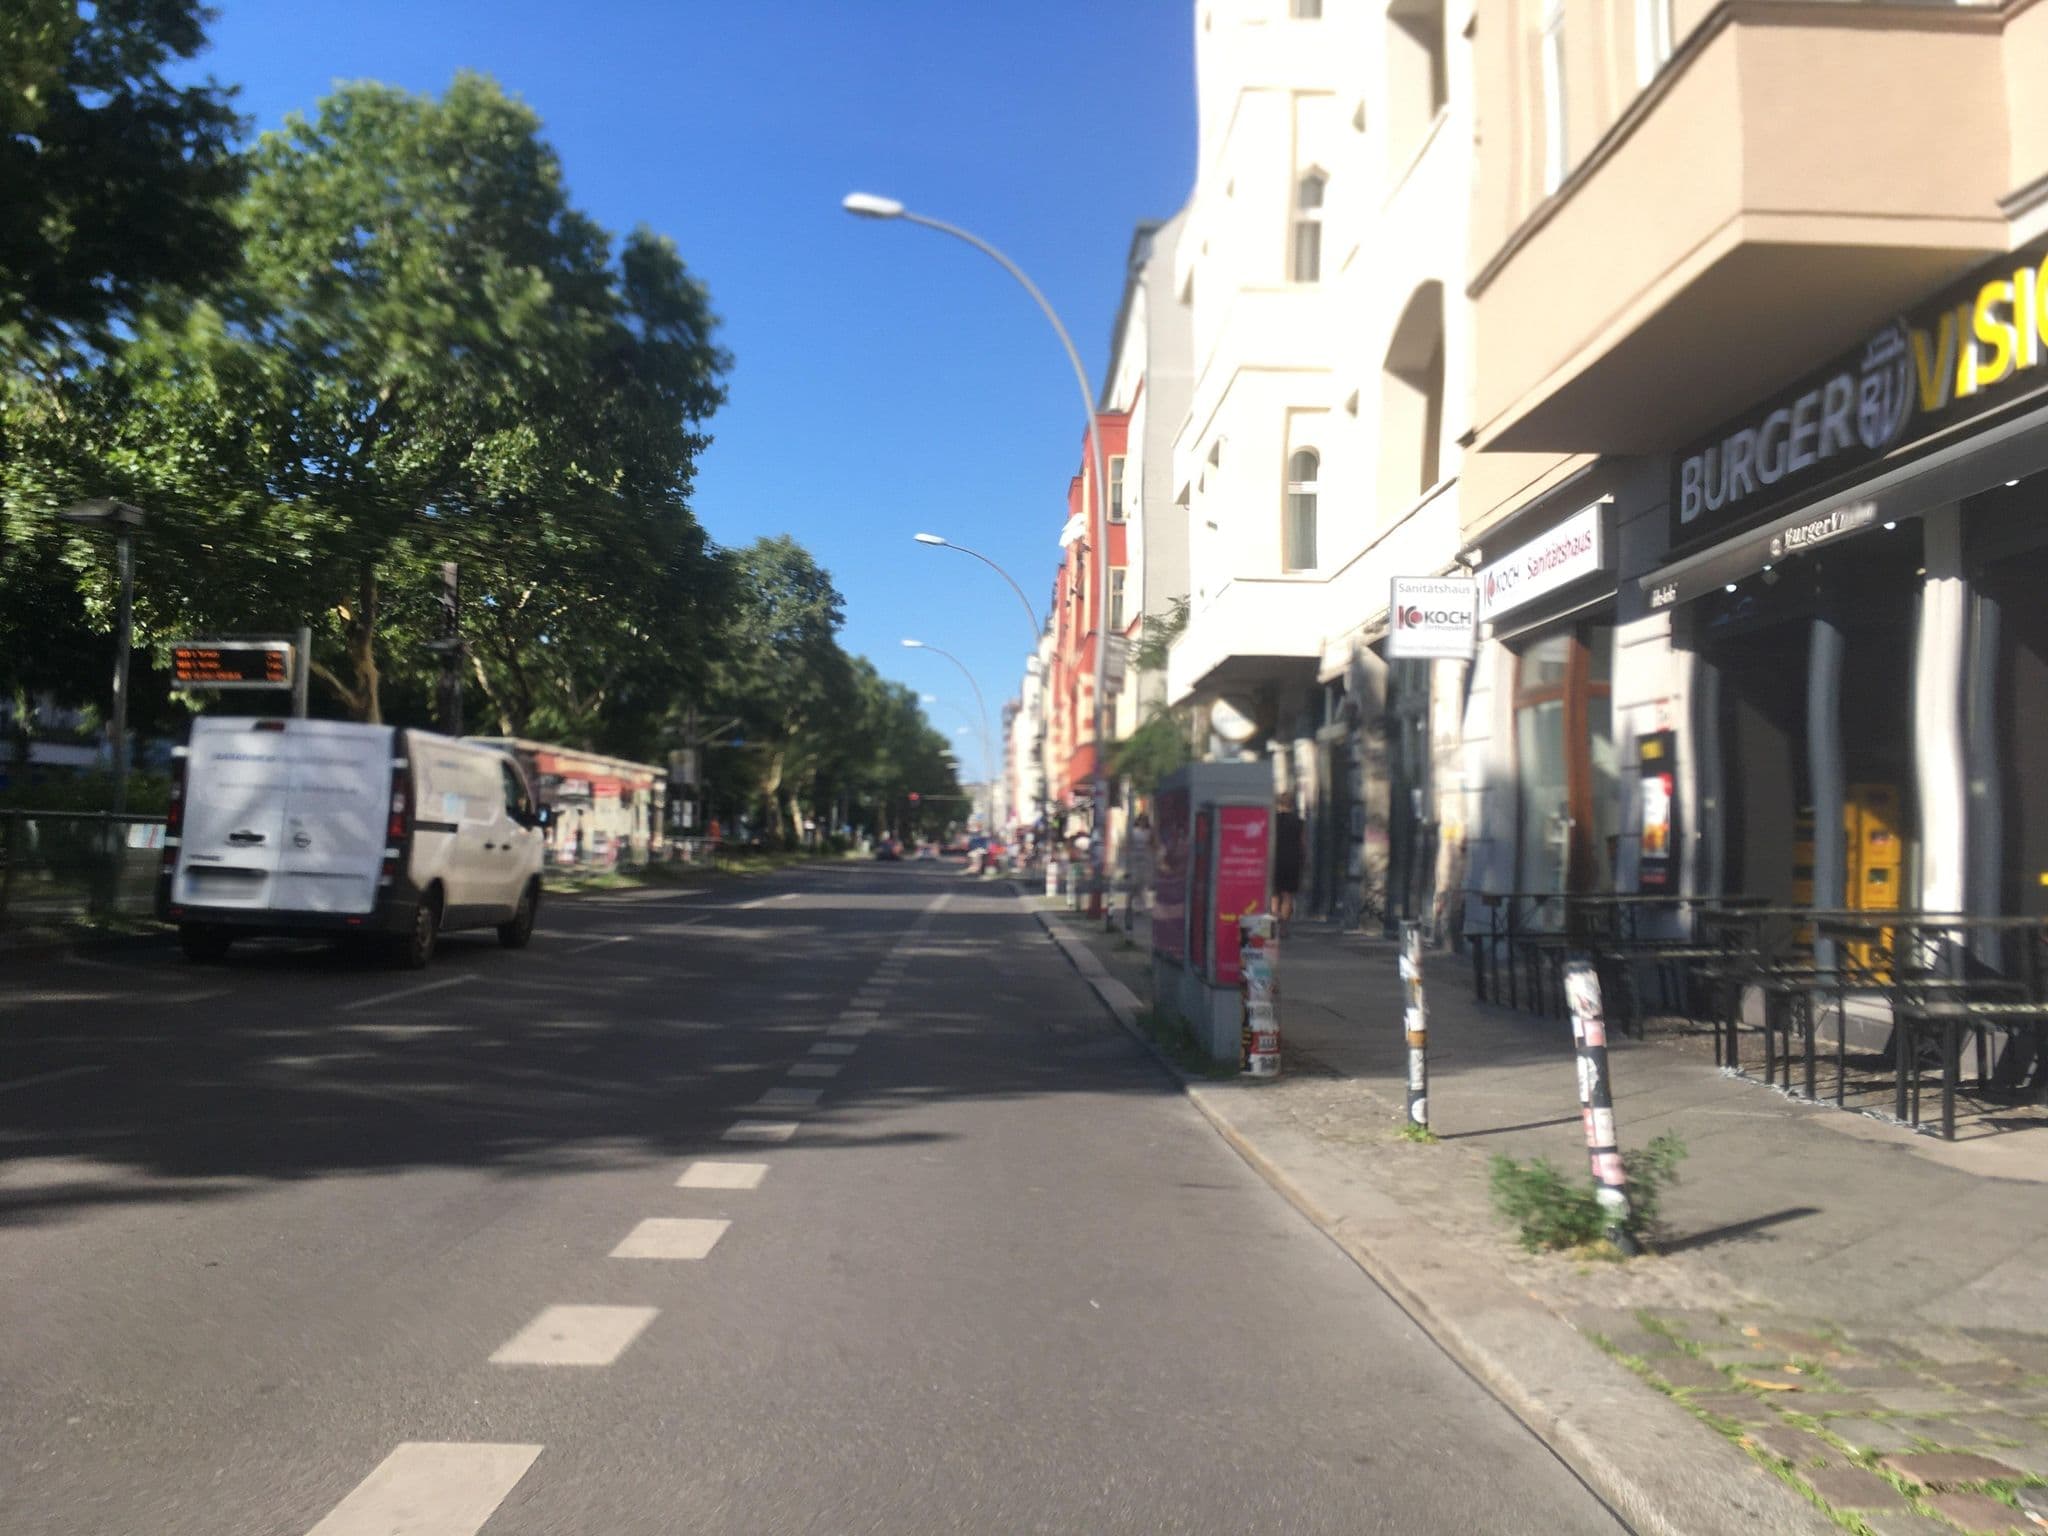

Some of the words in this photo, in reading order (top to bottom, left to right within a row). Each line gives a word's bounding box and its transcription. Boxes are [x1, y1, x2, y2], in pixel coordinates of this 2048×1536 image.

[1680, 373, 1855, 525] BURGER
[1912, 253, 2048, 412] VISI
[1496, 565, 1519, 594] KOCH
[1424, 610, 1473, 625] KOCH
